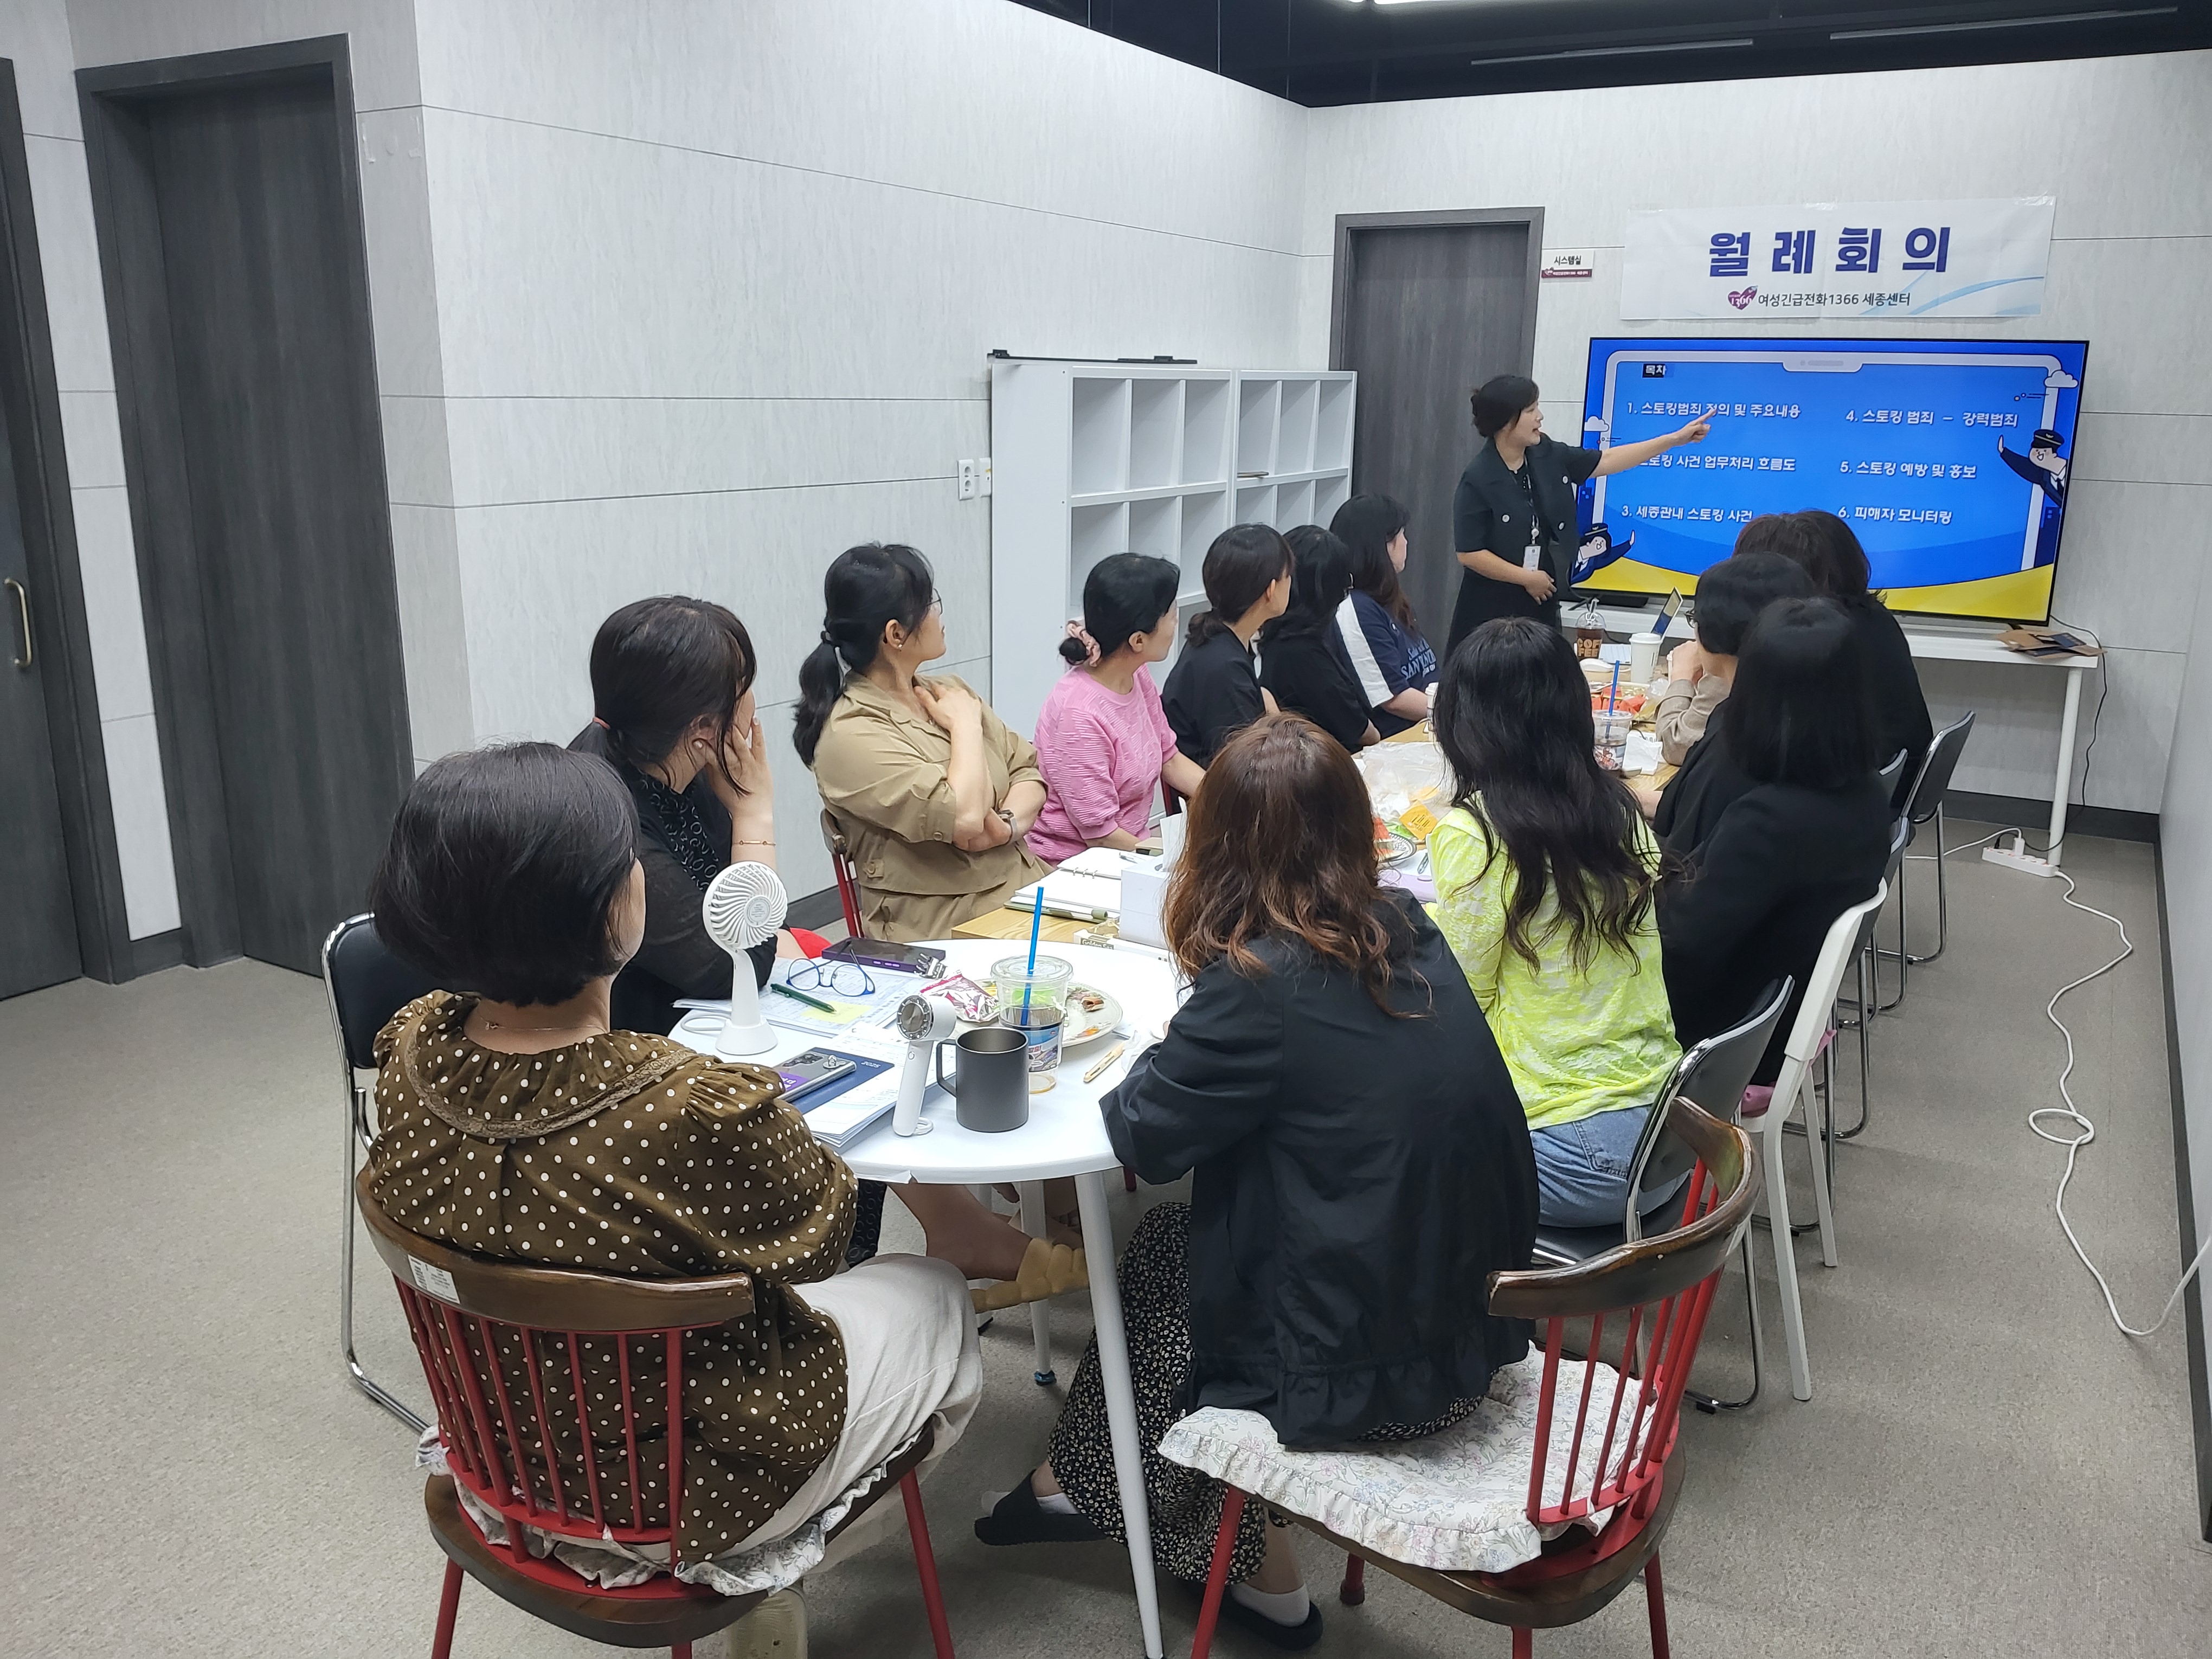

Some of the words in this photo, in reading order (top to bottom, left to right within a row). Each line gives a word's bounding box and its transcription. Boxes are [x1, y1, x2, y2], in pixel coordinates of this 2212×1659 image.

[1758, 292, 1859, 306] 여성긴급전화1366
[1862, 292, 1911, 306] 세종센터
[1645, 365, 1666, 375] 목차
[1627, 402, 1637, 414] 1.
[1641, 402, 1702, 416] 스토킹범죄
[1734, 403, 1747, 417] 및
[1750, 404, 1801, 419] 주요내용
[1846, 410, 1858, 422] 4.
[1862, 410, 1903, 424] 스토킹
[1907, 411, 1934, 425] 범죄
[1963, 412, 2018, 428] 강력범죄
[1639, 454, 1673, 467] 토킹
[1676, 455, 1701, 468] 사건
[1705, 455, 1754, 471] 업무처리
[1757, 458, 1796, 472] 흐름도
[1840, 461, 1853, 473] 5.
[1856, 461, 1897, 476] 스토킹
[1900, 463, 1928, 478] 예방
[1932, 464, 1945, 478] 및
[1949, 464, 1977, 479] 홍보
[1621, 505, 1632, 517] 3.
[1636, 506, 1683, 520] 세종관내
[1687, 509, 1724, 522] 스토킹
[1727, 509, 1753, 523] 사건
[1838, 506, 1850, 519] 6.
[1854, 506, 1895, 521] 피해자
[1897, 509, 1952, 525] 모니터링
